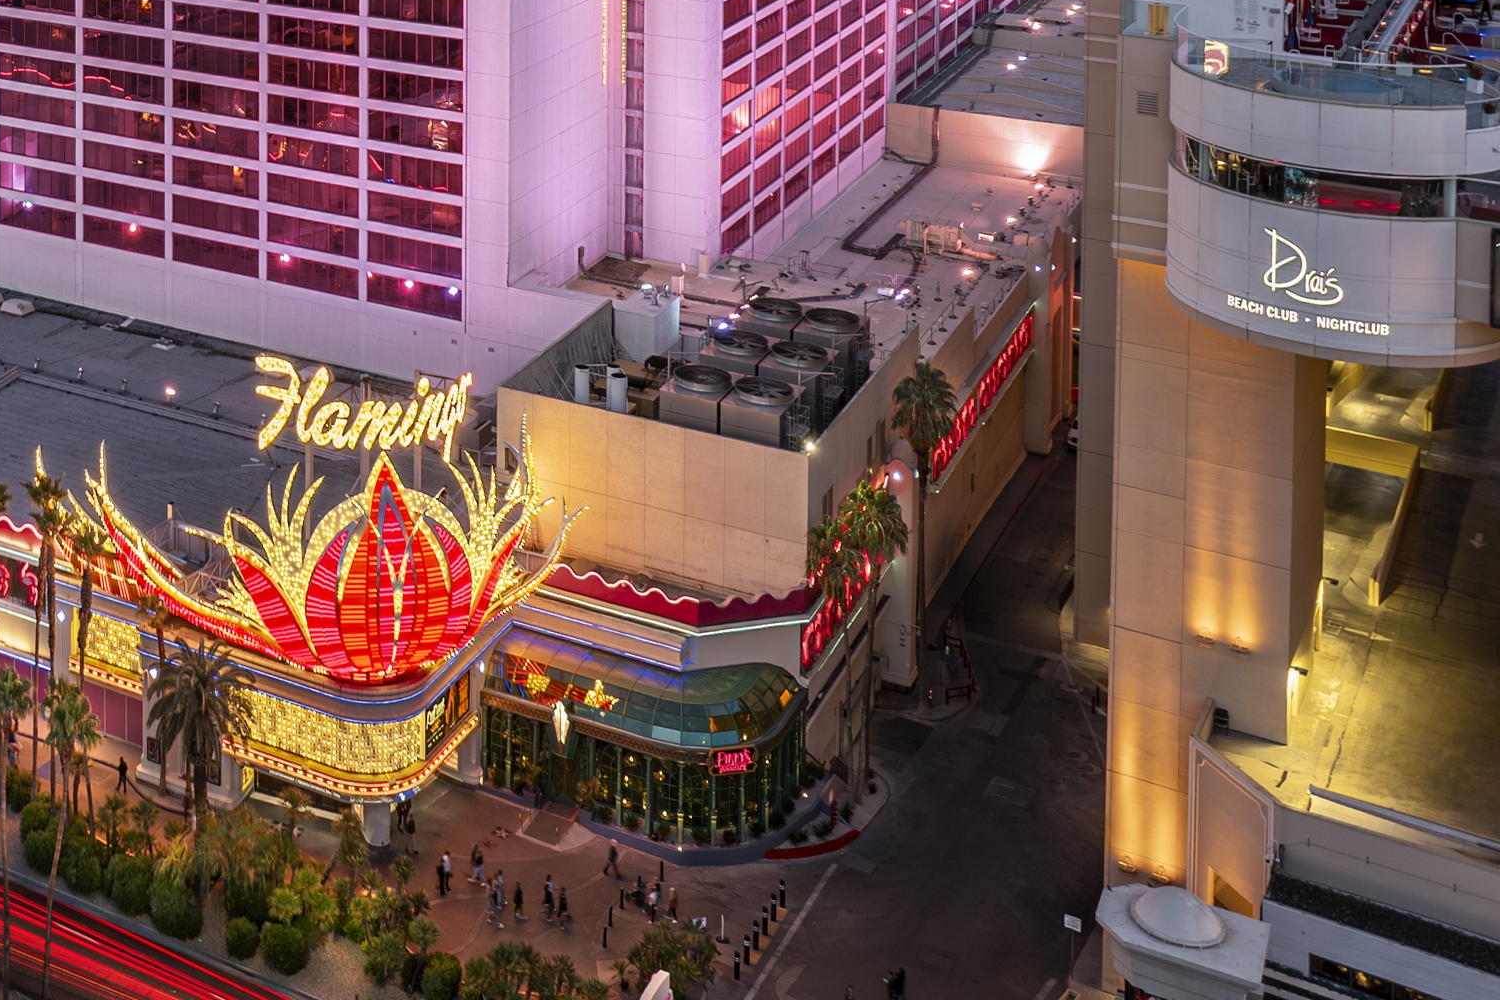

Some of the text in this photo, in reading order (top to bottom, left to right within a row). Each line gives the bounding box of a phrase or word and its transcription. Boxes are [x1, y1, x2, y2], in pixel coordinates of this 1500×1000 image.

[1263, 227, 1344, 306] Drai's
[1227, 295, 1390, 336] BEACH CLUB NIGHTCLUB
[255, 355, 474, 465] Flamingo
